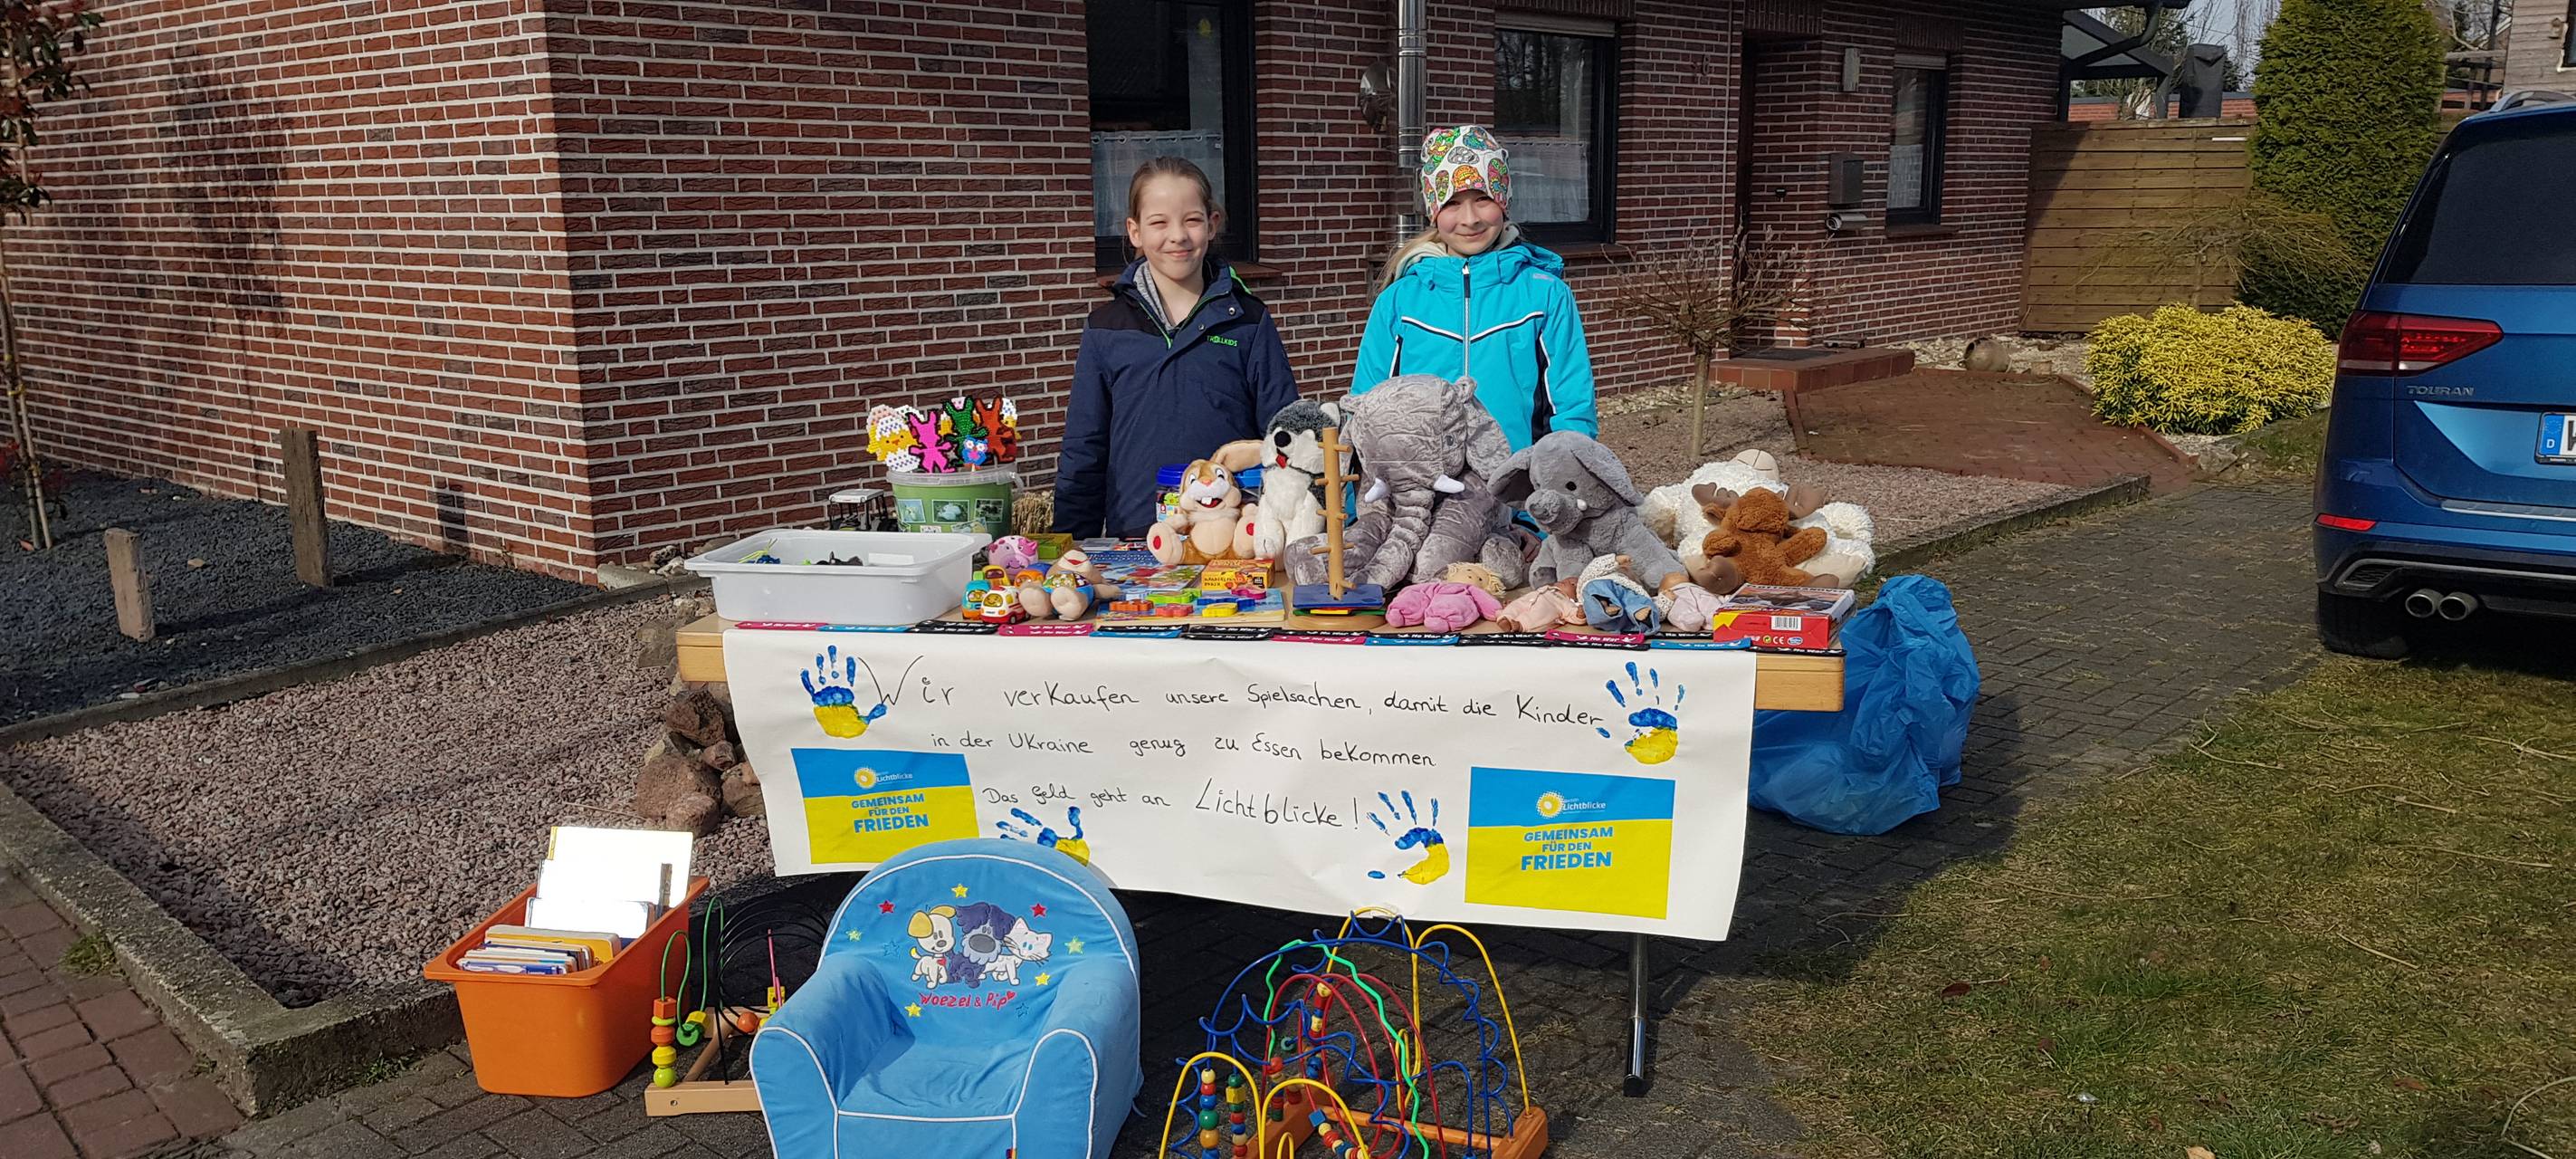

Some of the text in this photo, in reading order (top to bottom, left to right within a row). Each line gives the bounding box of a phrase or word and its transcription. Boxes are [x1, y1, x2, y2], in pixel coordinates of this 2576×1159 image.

[2406, 385, 2475, 397] TOURAN
[2546, 438, 2555, 449] D
[857, 655, 955, 705] Wir
[1166, 692, 1229, 704] unsere
[1384, 691, 1449, 712] damit
[1463, 698, 1497, 716] die
[1516, 694, 1605, 725] Kinder
[930, 733, 950, 747] in
[959, 730, 994, 748] der
[1130, 737, 1186, 757] genug
[1215, 736, 1239, 751] zu
[1251, 732, 1302, 761] Essen
[876, 773, 913, 783] Lichtblicke
[852, 793, 925, 809] GEMEINSAM
[982, 787, 1019, 804] Das
[1091, 787, 1128, 808] geht
[1142, 794, 1171, 807] an
[869, 807, 910, 817] FÜR DEN
[1563, 801, 1607, 811] Lichtblicke
[854, 814, 930, 833] FRIEDEN
[1523, 826, 1614, 842] GEMEINSAM
[1541, 840, 1592, 853] FÜR DEN
[1521, 851, 1612, 871] FRIEDEN
[919, 992, 1007, 1011] Woezel & Pip
